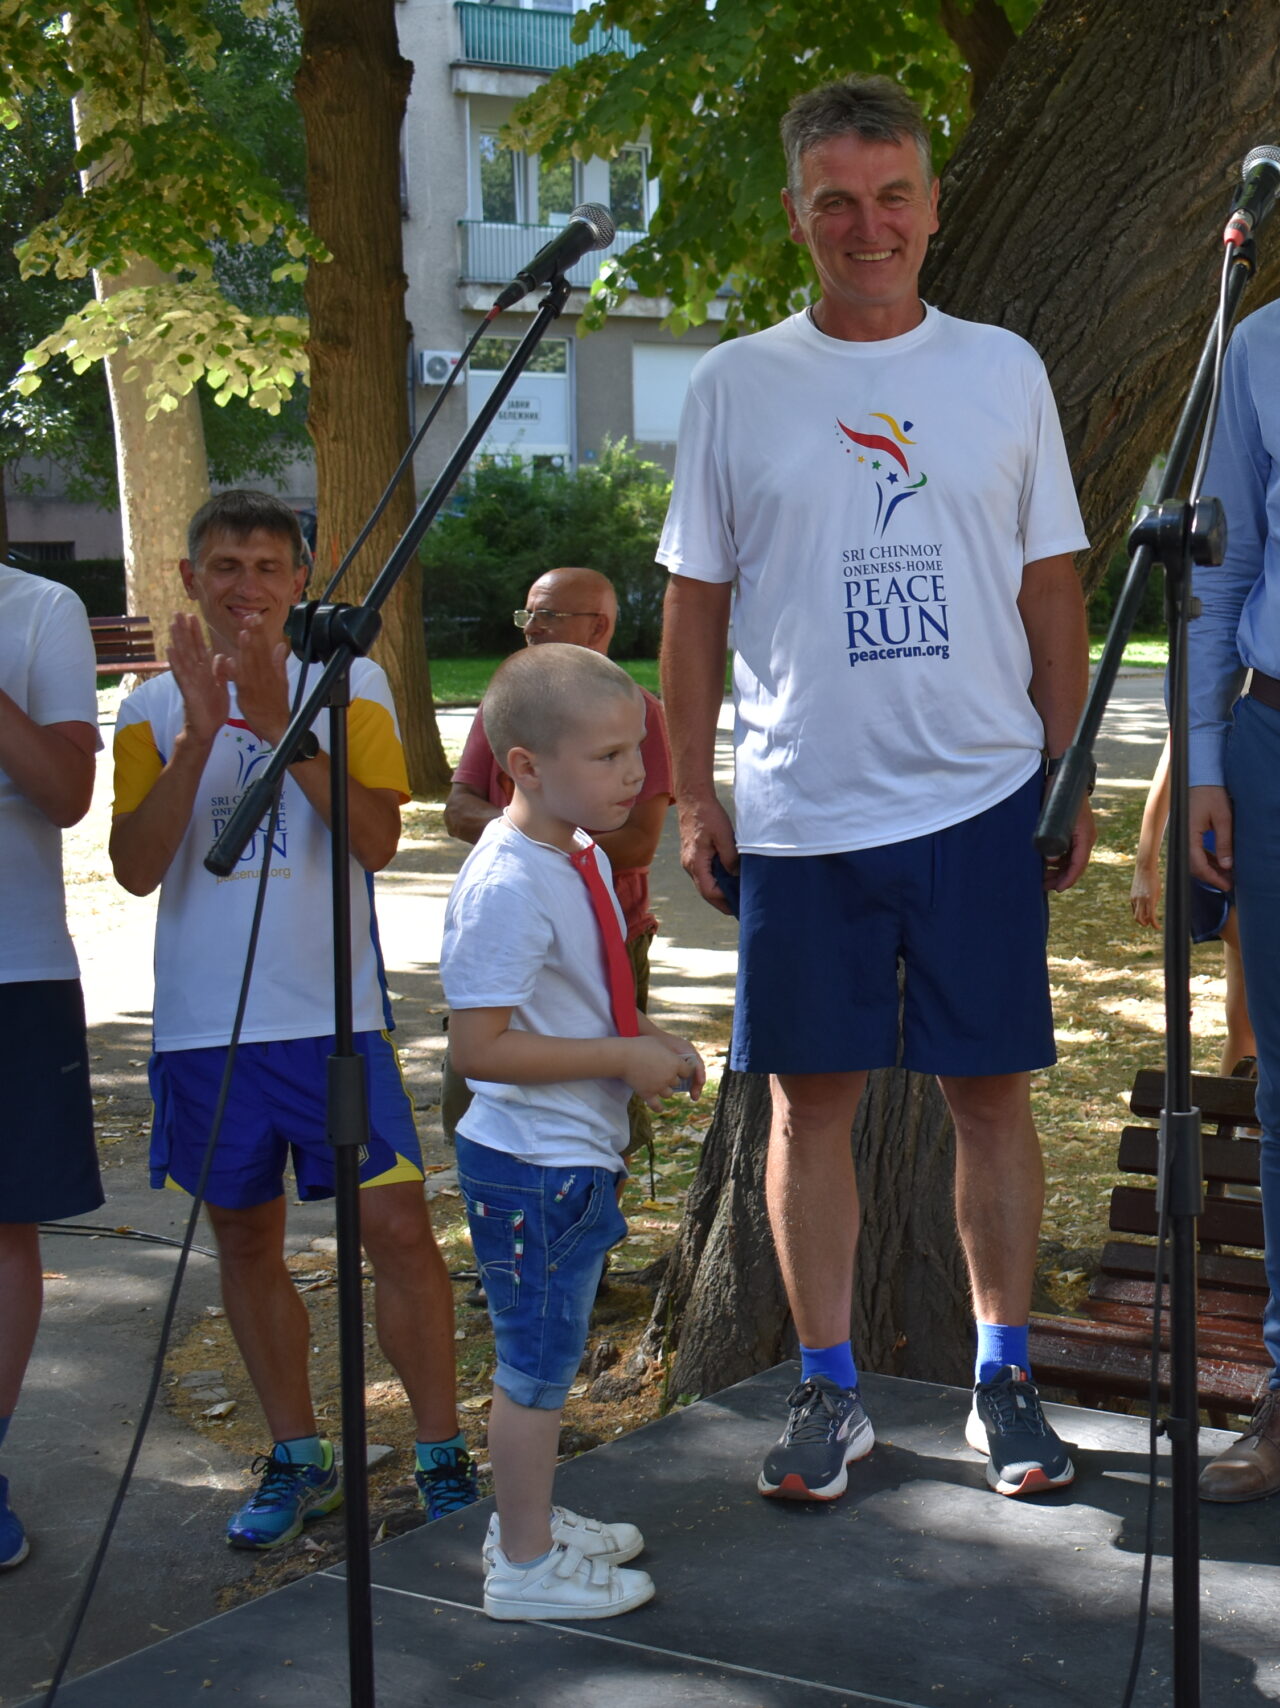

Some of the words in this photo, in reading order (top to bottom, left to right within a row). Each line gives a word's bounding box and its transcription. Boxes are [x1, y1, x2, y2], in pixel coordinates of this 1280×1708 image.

[842, 548, 865, 562] SRI
[869, 544, 942, 559] CHINMOY
[843, 560, 944, 577] ONENESS-HOME
[843, 575, 946, 608] PEACE
[843, 604, 949, 649] RUN
[849, 645, 949, 667] peacerun.org
[211, 796, 229, 806] SRI
[211, 832, 288, 861] UN
